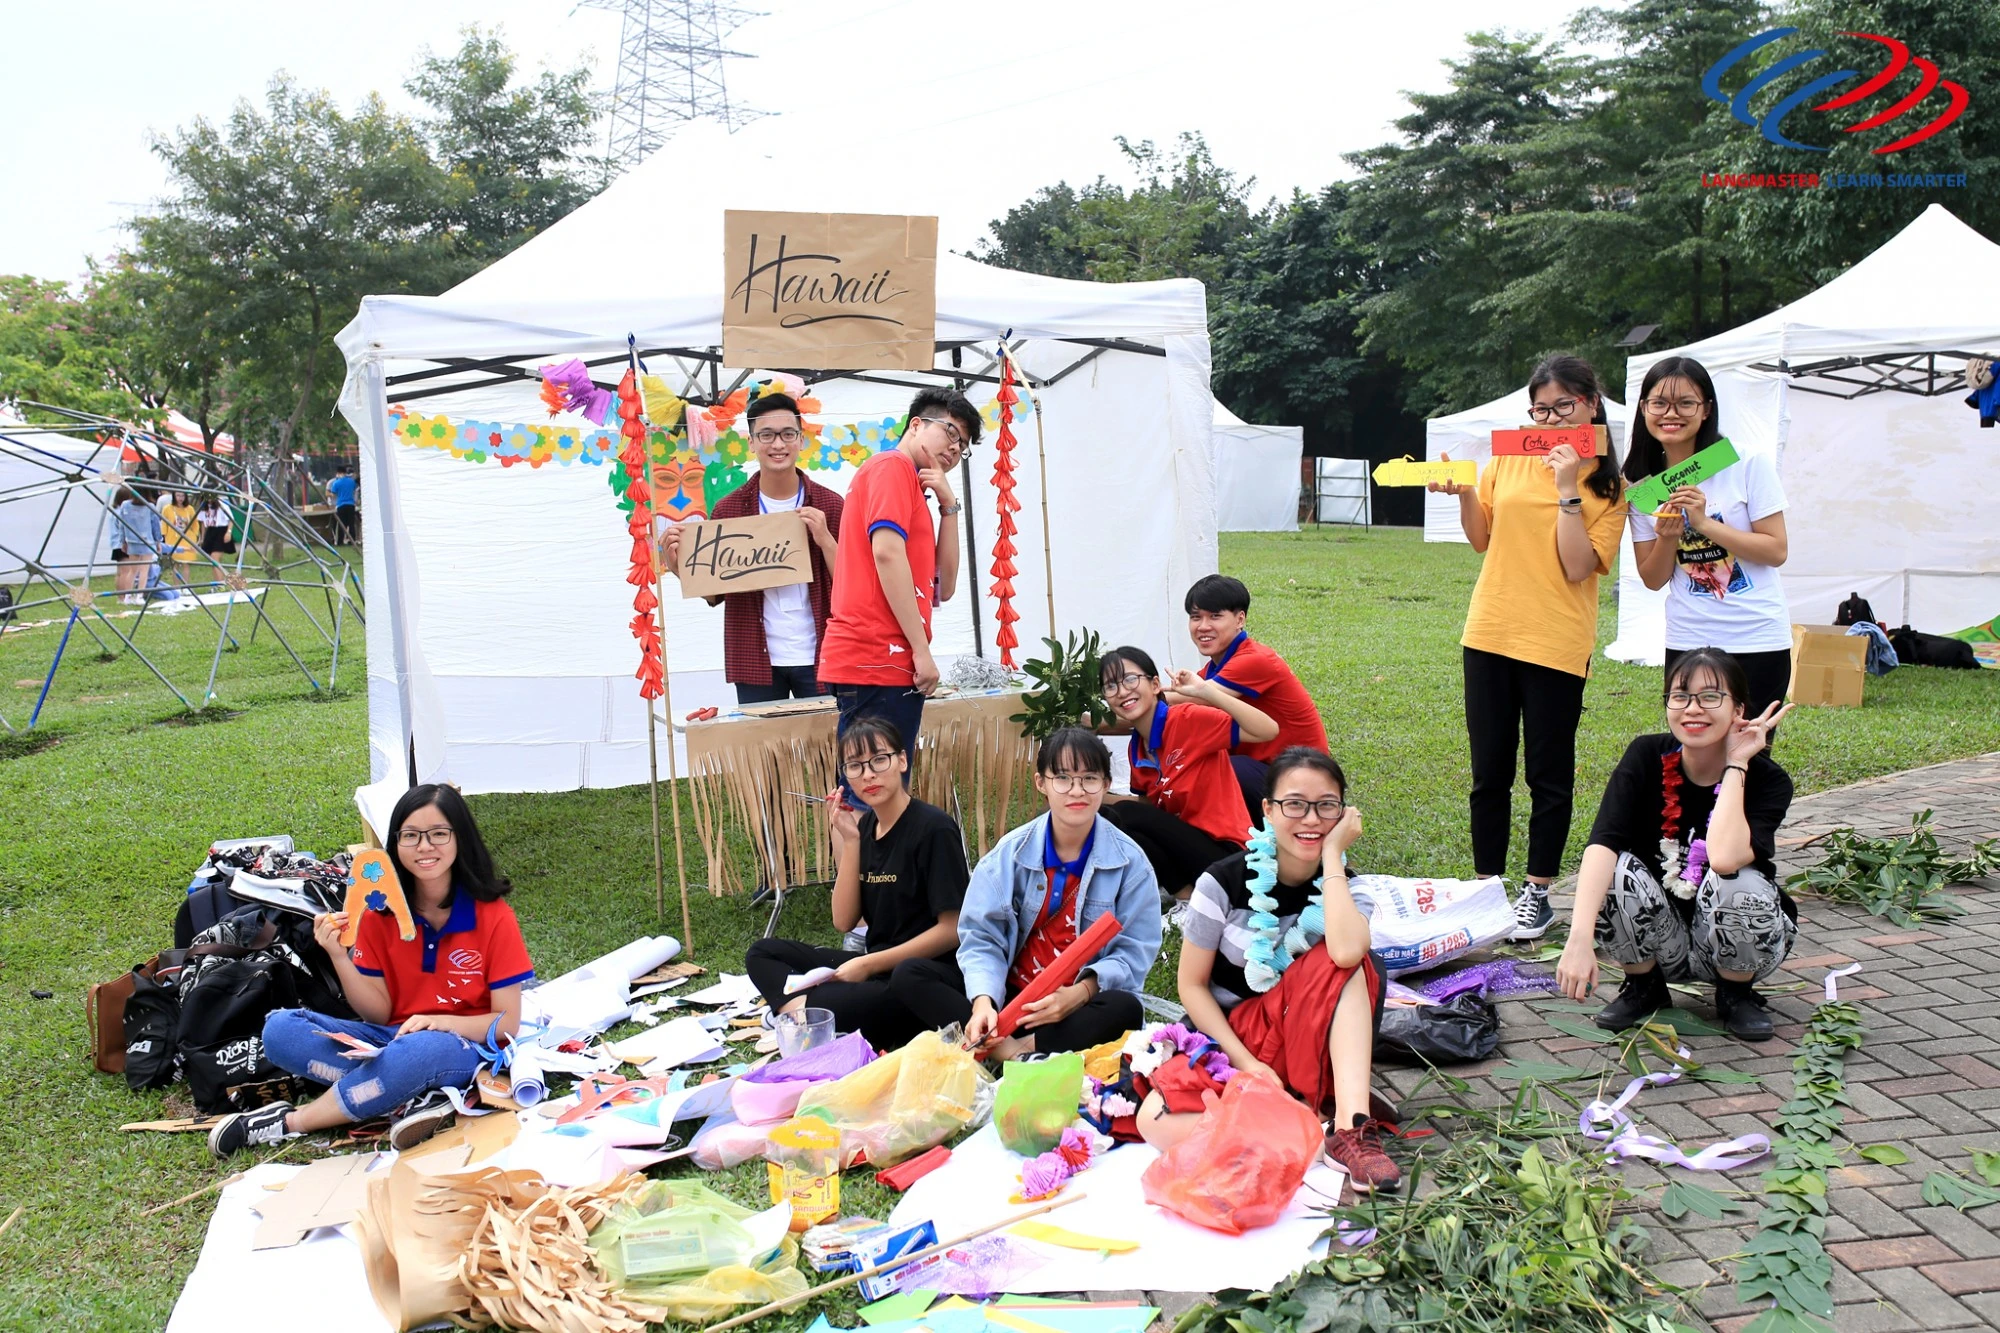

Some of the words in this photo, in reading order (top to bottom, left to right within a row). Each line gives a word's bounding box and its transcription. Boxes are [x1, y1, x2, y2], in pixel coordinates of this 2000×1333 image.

[731, 234, 909, 320] Hawaii
[1523, 435, 1551, 451] Coke
[1661, 460, 1702, 486] Coconut
[685, 525, 799, 579] Hawaii
[1704, 549, 1722, 559] HILLS
[226, 1065, 242, 1076] FORT
